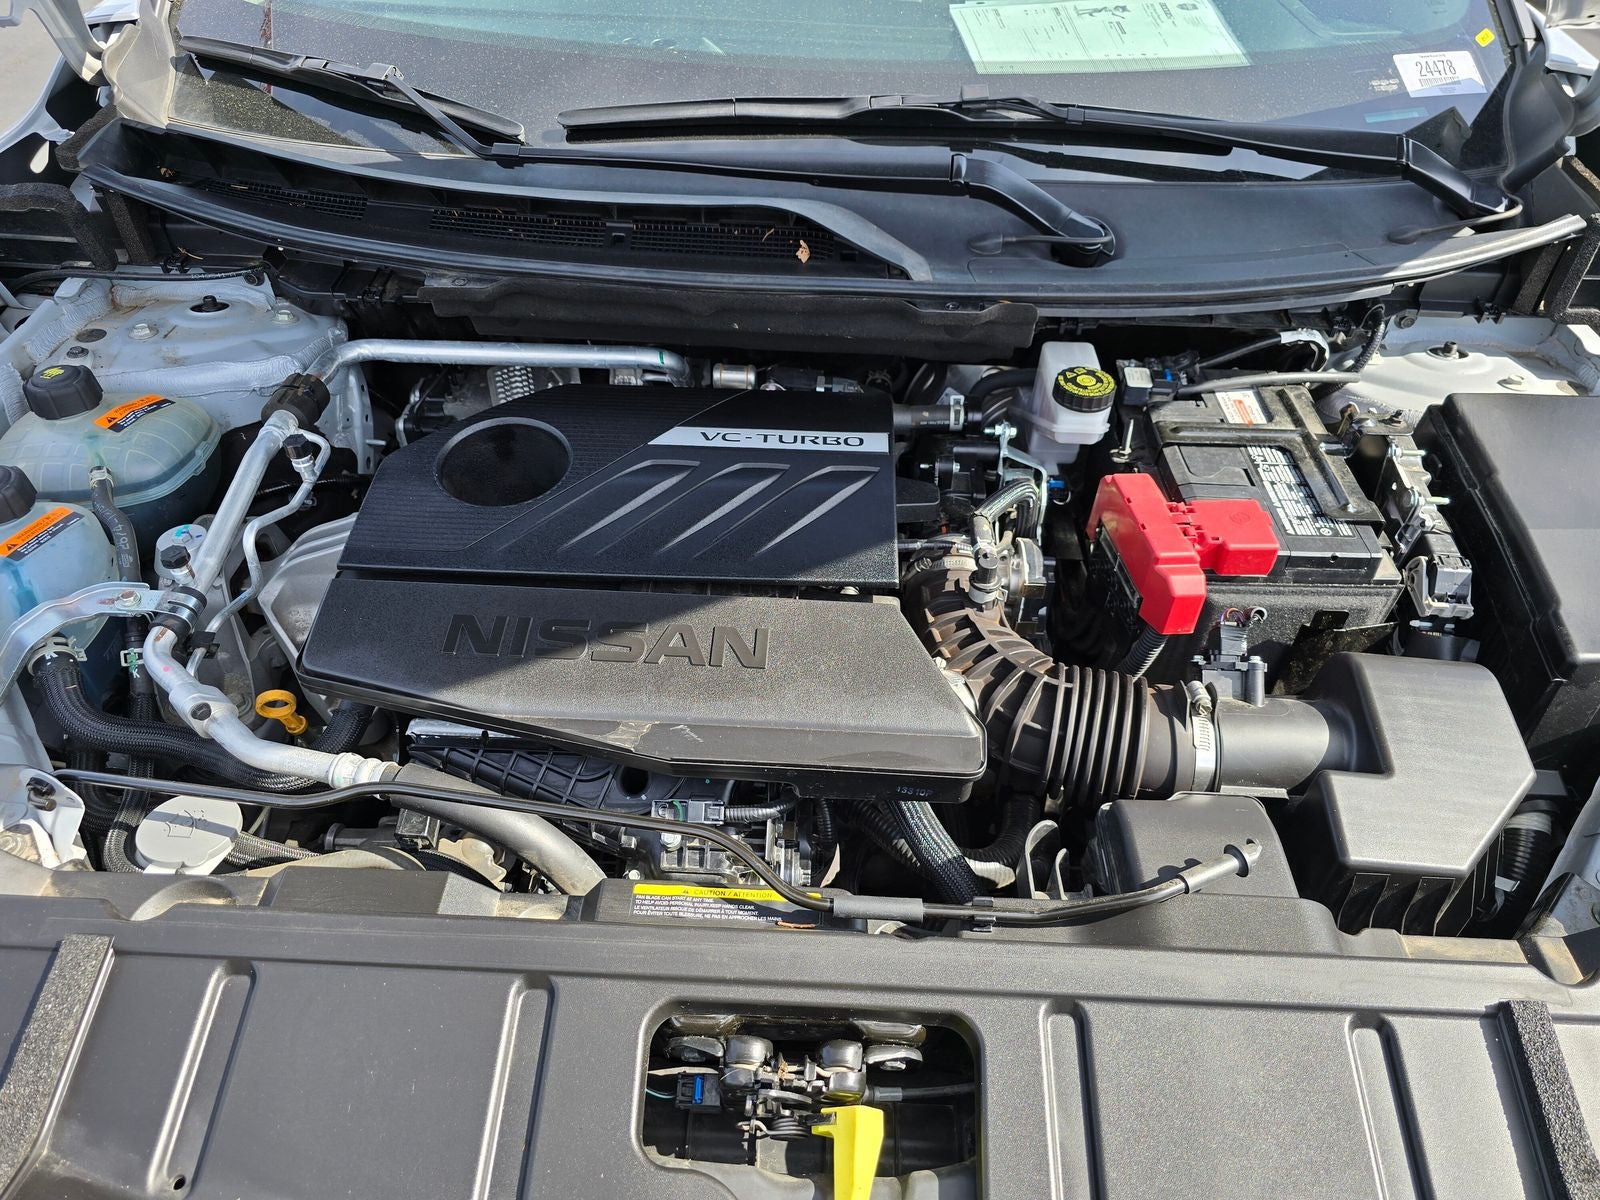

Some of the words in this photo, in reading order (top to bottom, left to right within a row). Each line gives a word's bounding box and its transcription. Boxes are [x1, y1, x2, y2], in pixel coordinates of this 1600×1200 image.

[1415, 59, 1457, 77] 24478
[700, 431, 864, 447] VC-TURBO
[442, 614, 769, 669] NISSAN
